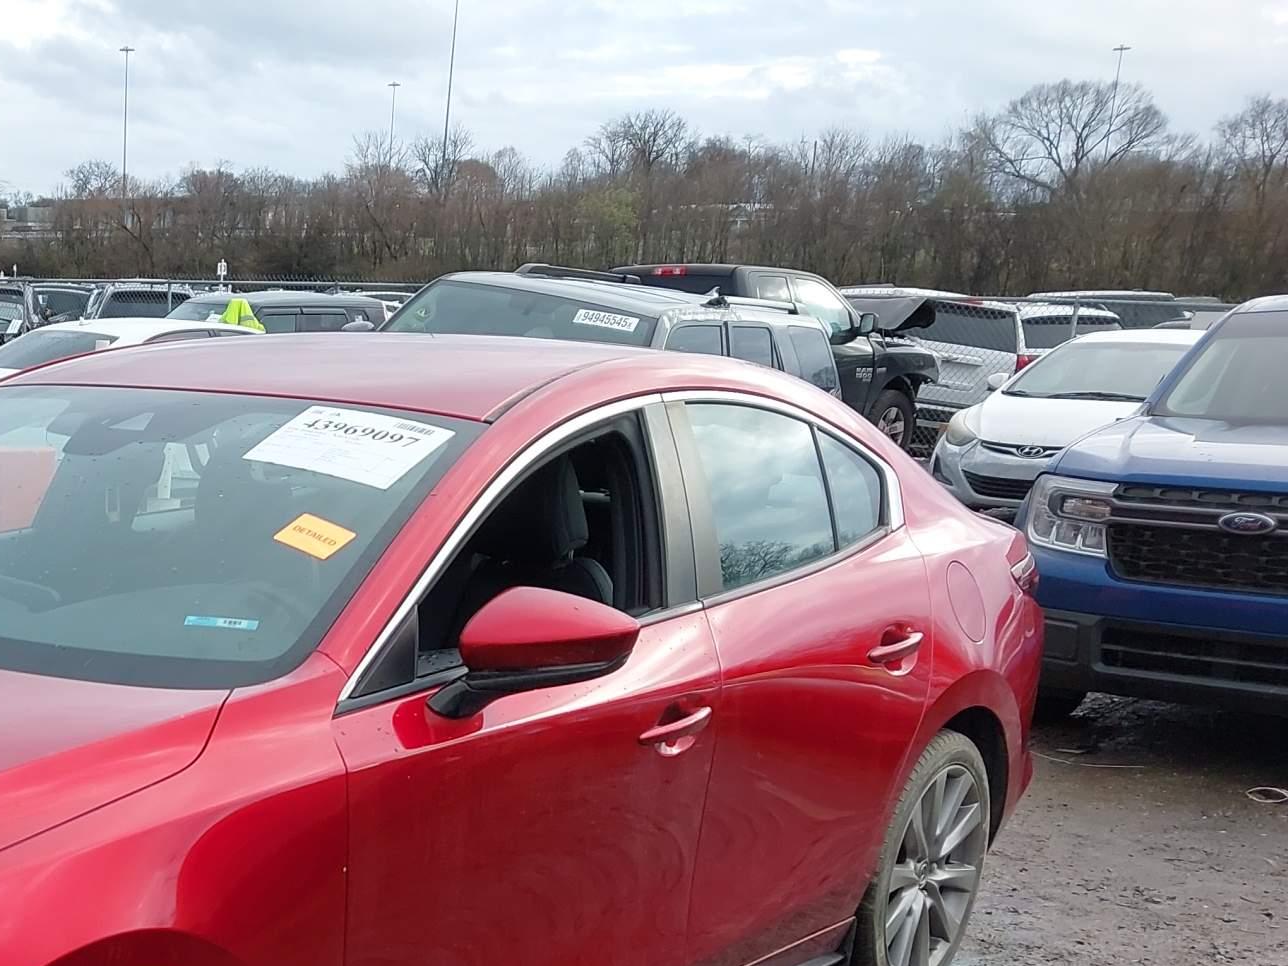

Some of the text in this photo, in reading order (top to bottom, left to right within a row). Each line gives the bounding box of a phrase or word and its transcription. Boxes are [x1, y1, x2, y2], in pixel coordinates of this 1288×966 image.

[581, 311, 628, 328] 94945545
[303, 417, 421, 448] 43969097
[292, 524, 337, 546] DETAILED
